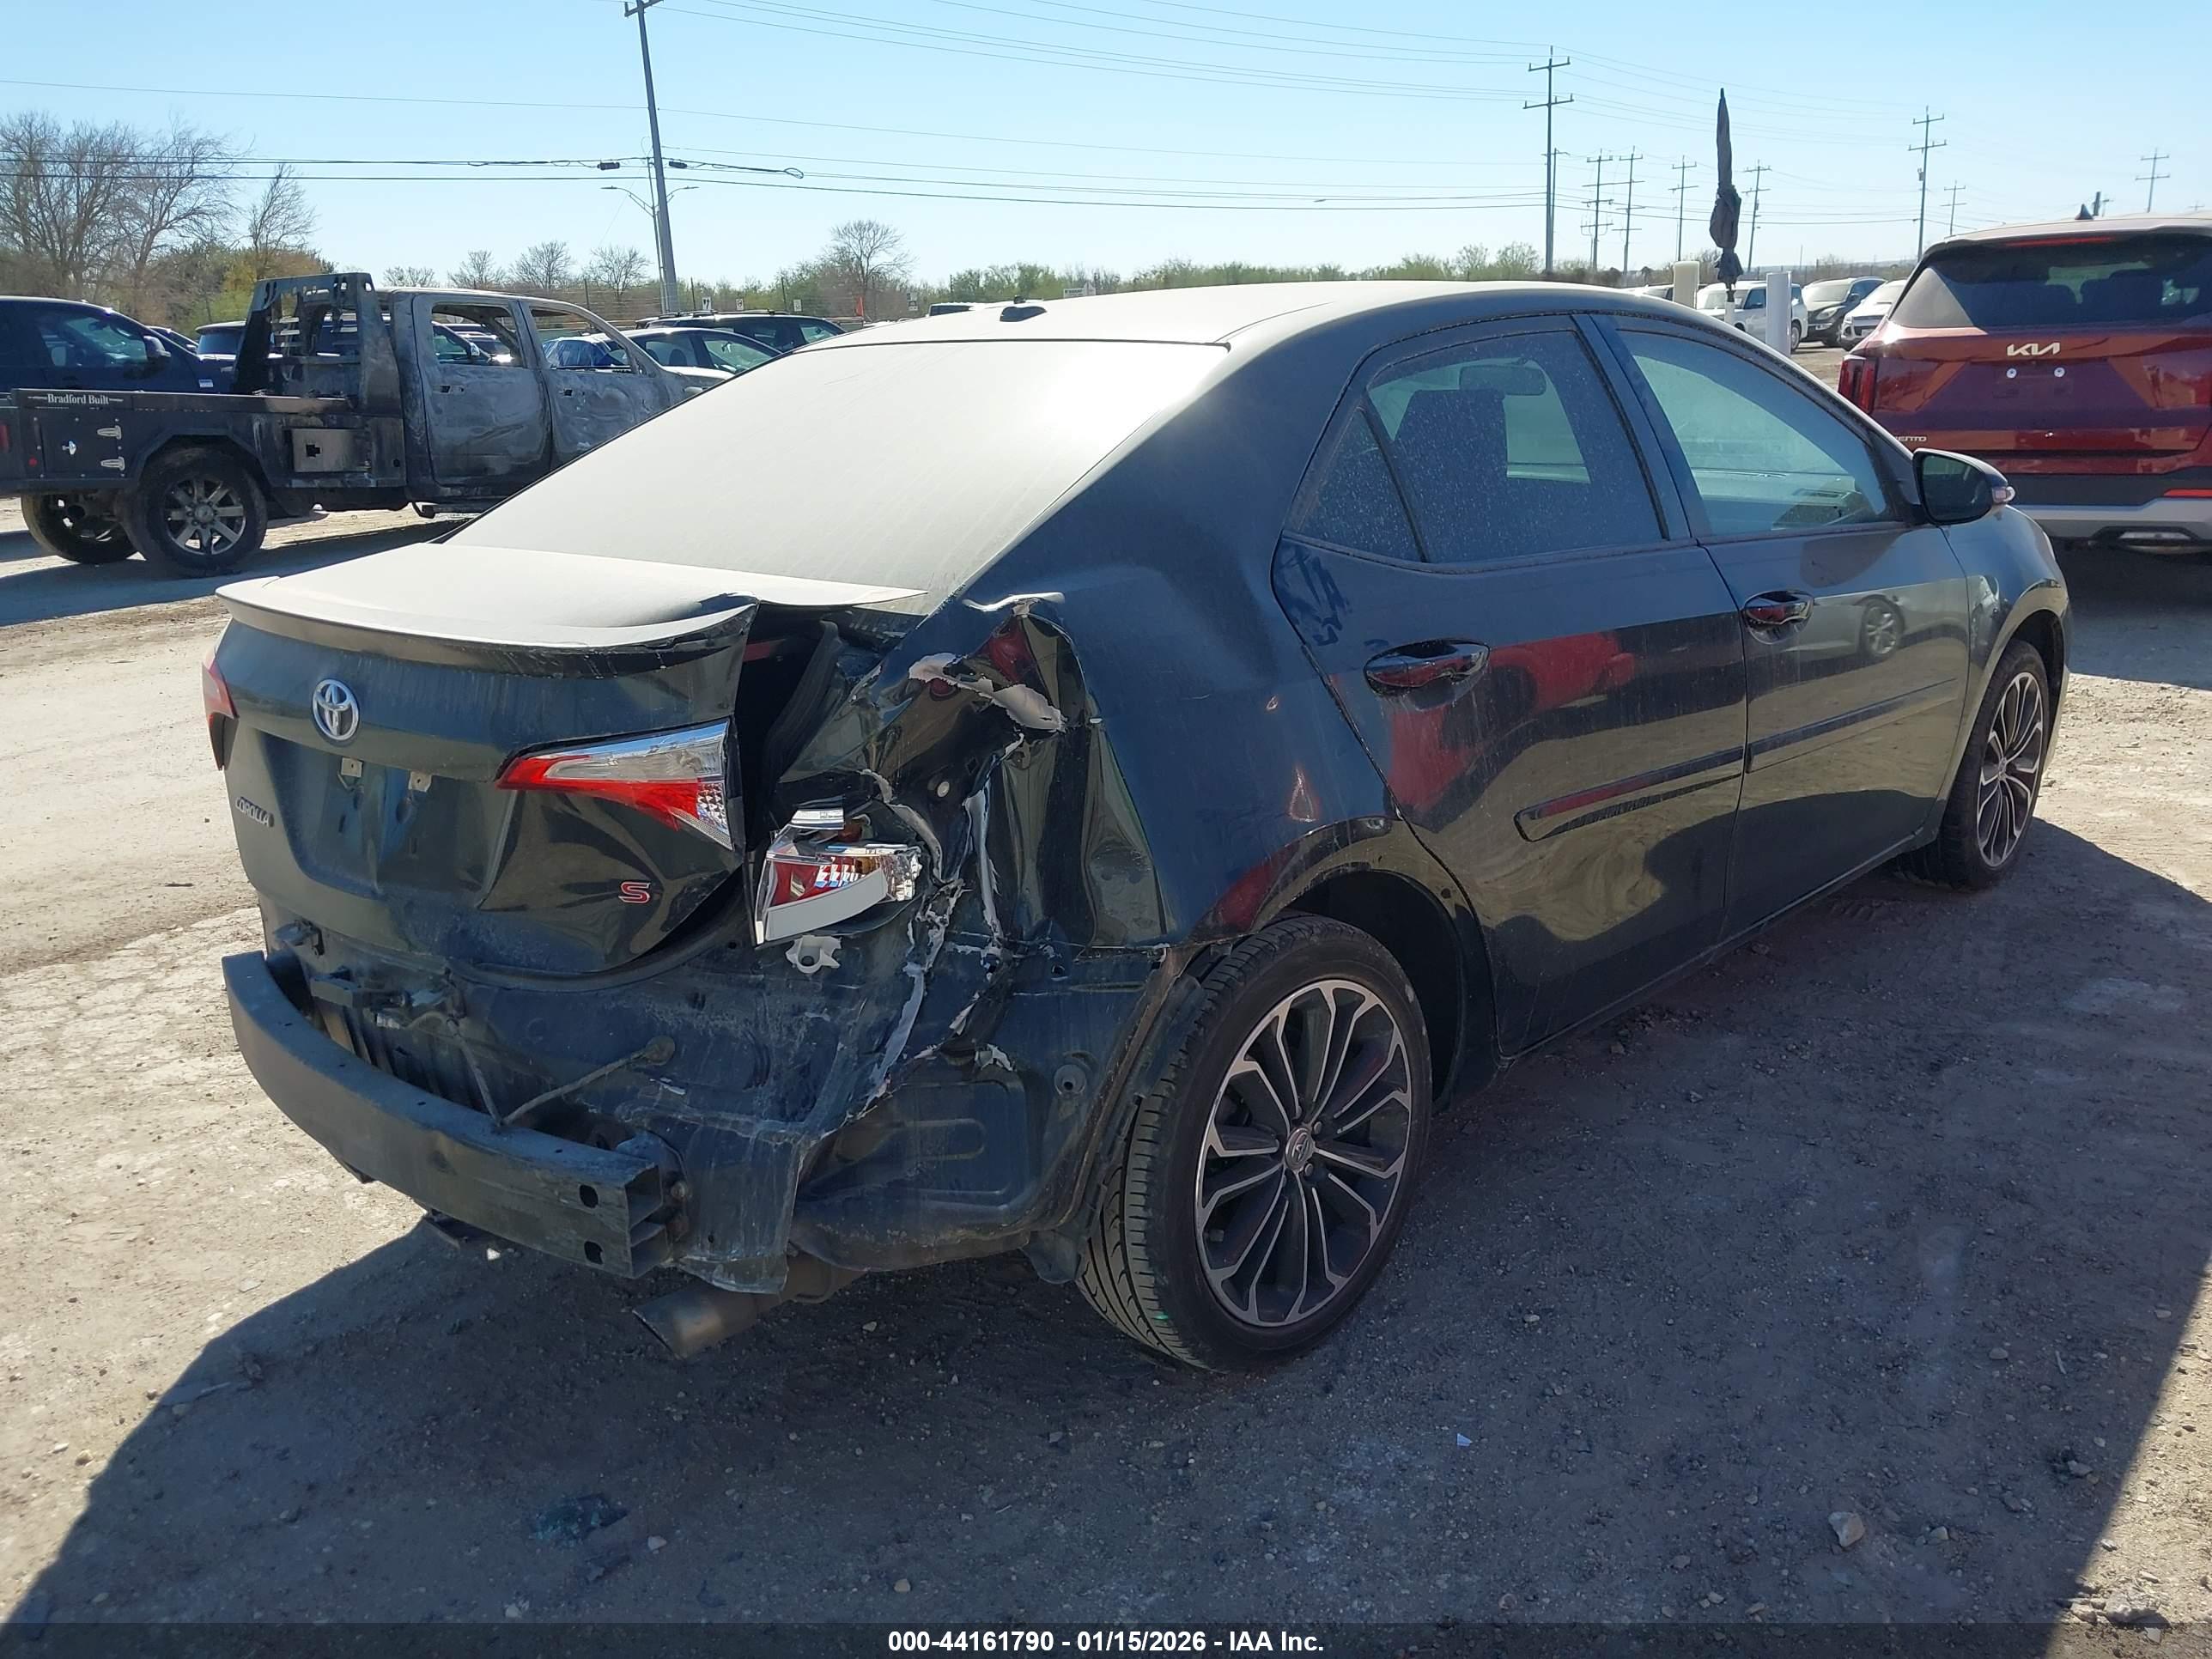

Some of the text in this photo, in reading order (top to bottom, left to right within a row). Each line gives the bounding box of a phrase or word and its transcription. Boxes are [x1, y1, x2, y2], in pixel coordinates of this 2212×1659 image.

[2007, 342, 2060, 356] KIA
[47, 393, 109, 404] Bradford Built
[235, 797, 270, 828] COROLLA
[618, 881, 651, 903] S
